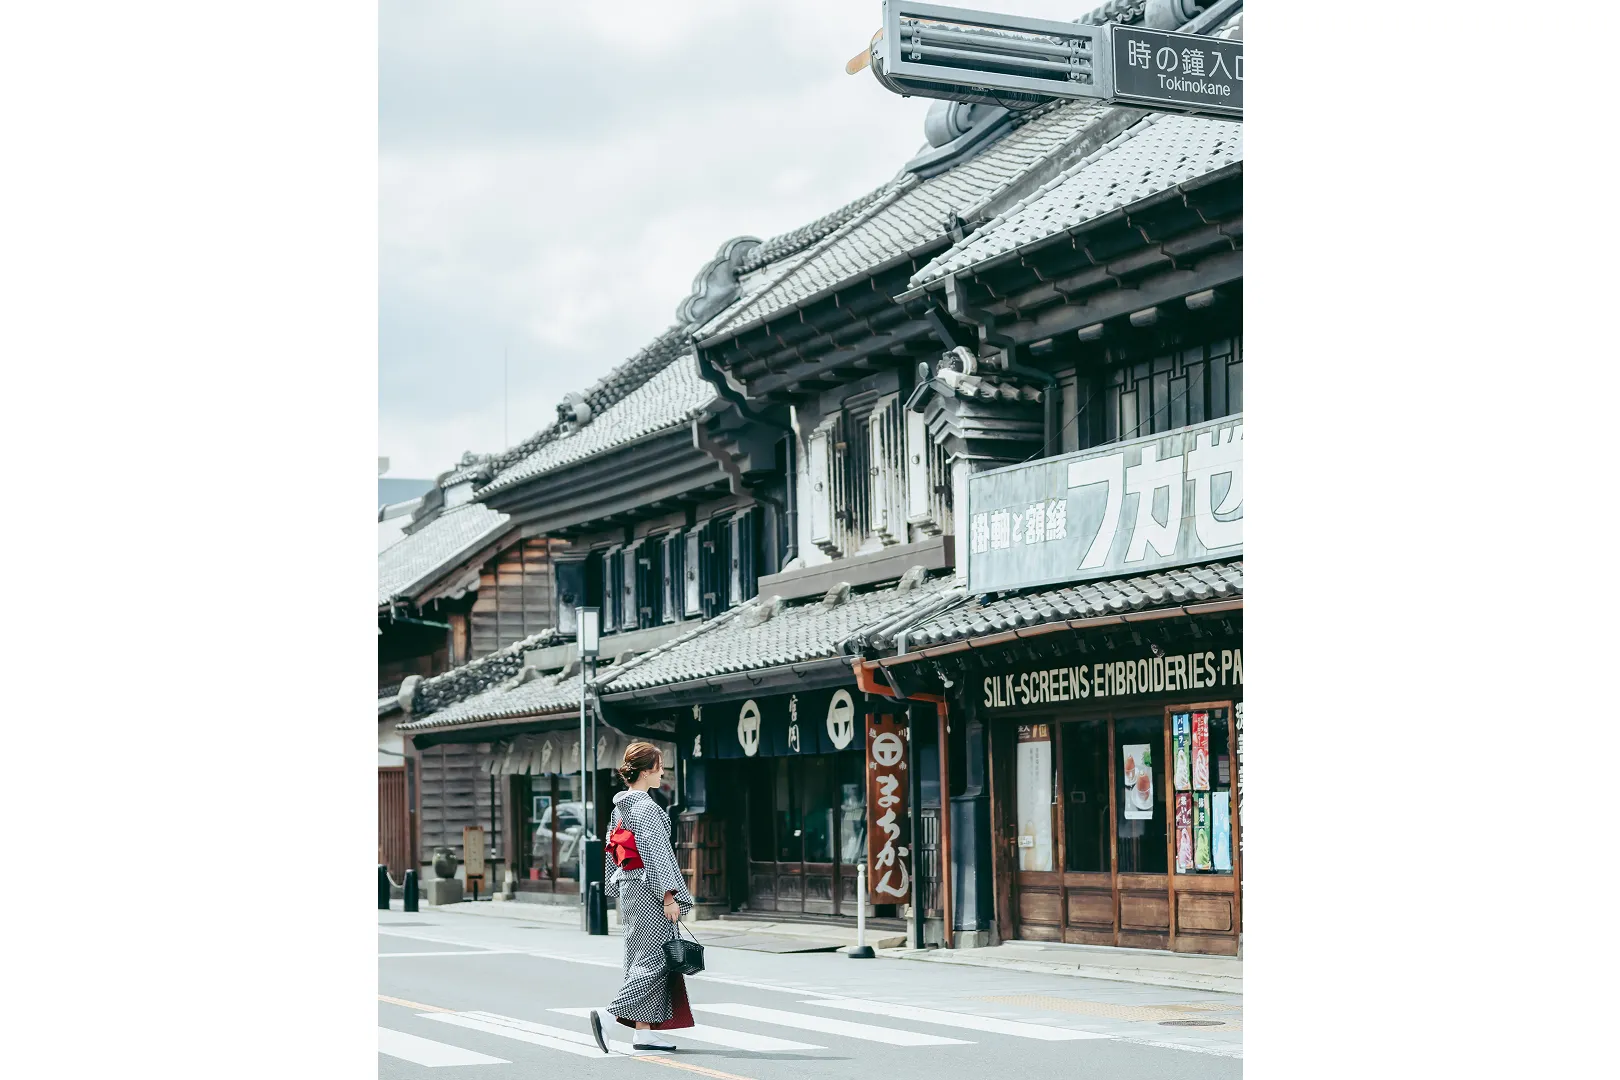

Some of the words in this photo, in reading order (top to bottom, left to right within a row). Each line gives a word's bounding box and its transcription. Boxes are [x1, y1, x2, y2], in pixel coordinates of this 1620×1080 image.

[1157, 73, 1231, 97] Tokinokane
[875, 773, 909, 898] まちかん
